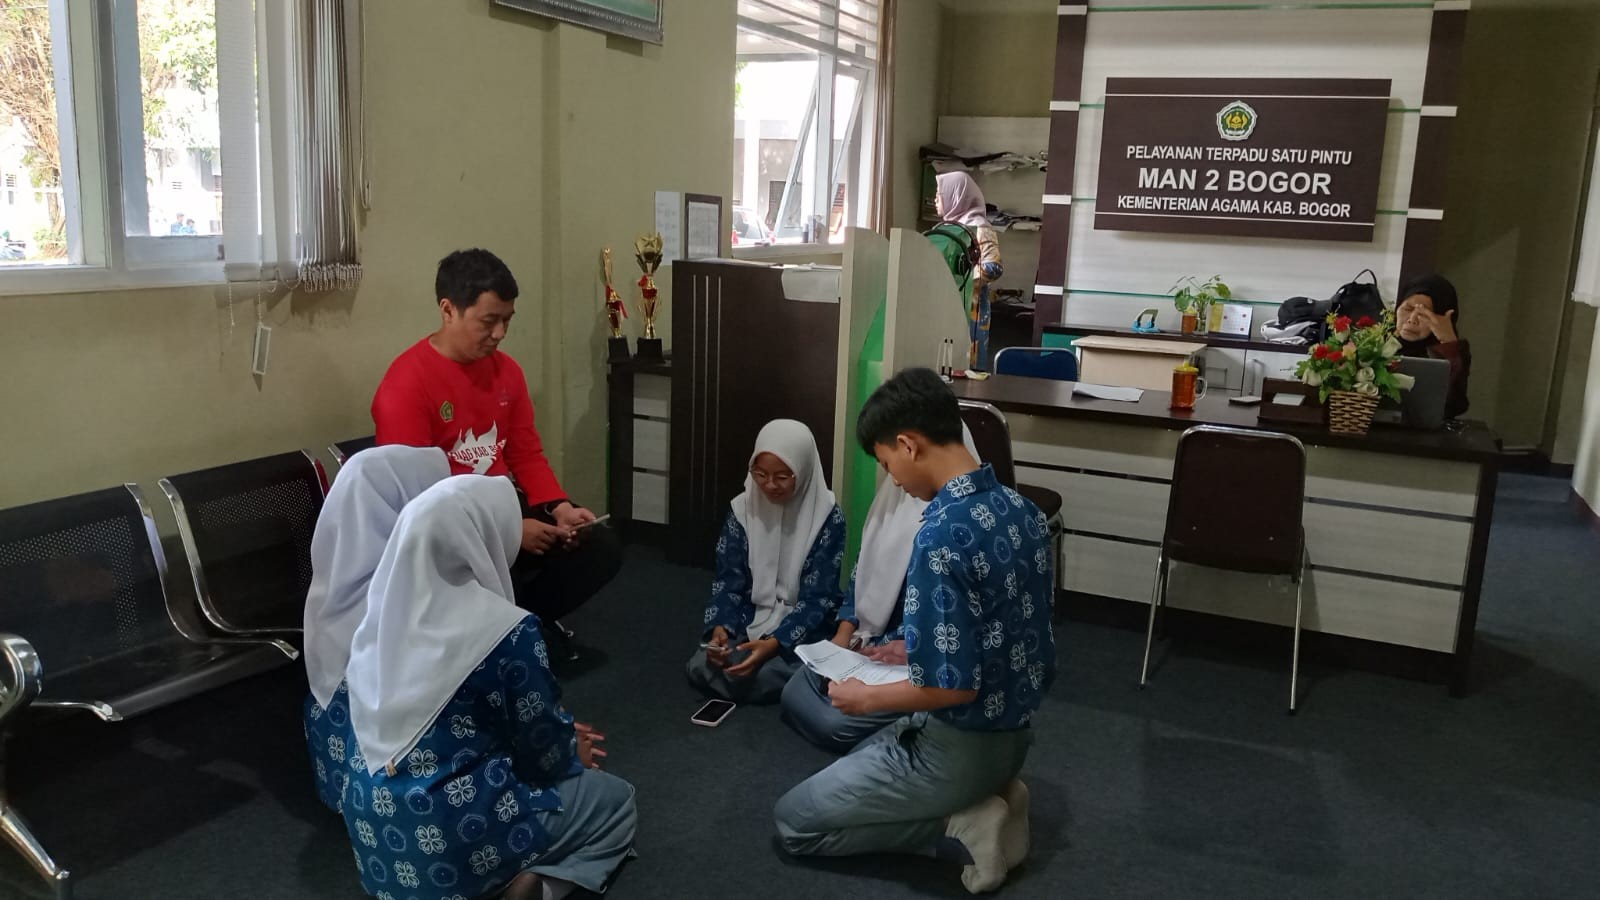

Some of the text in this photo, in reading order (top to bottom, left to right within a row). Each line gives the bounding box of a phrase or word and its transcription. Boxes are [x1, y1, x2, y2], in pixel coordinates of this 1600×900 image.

[1126, 145, 1352, 165] PELAYANAN TERPADU SATU PINTU
[1138, 168, 1331, 195] MAN 2 BOGOR
[1117, 195, 1351, 217] KEMENTERIAN AGAMA KAB. BOGOR
